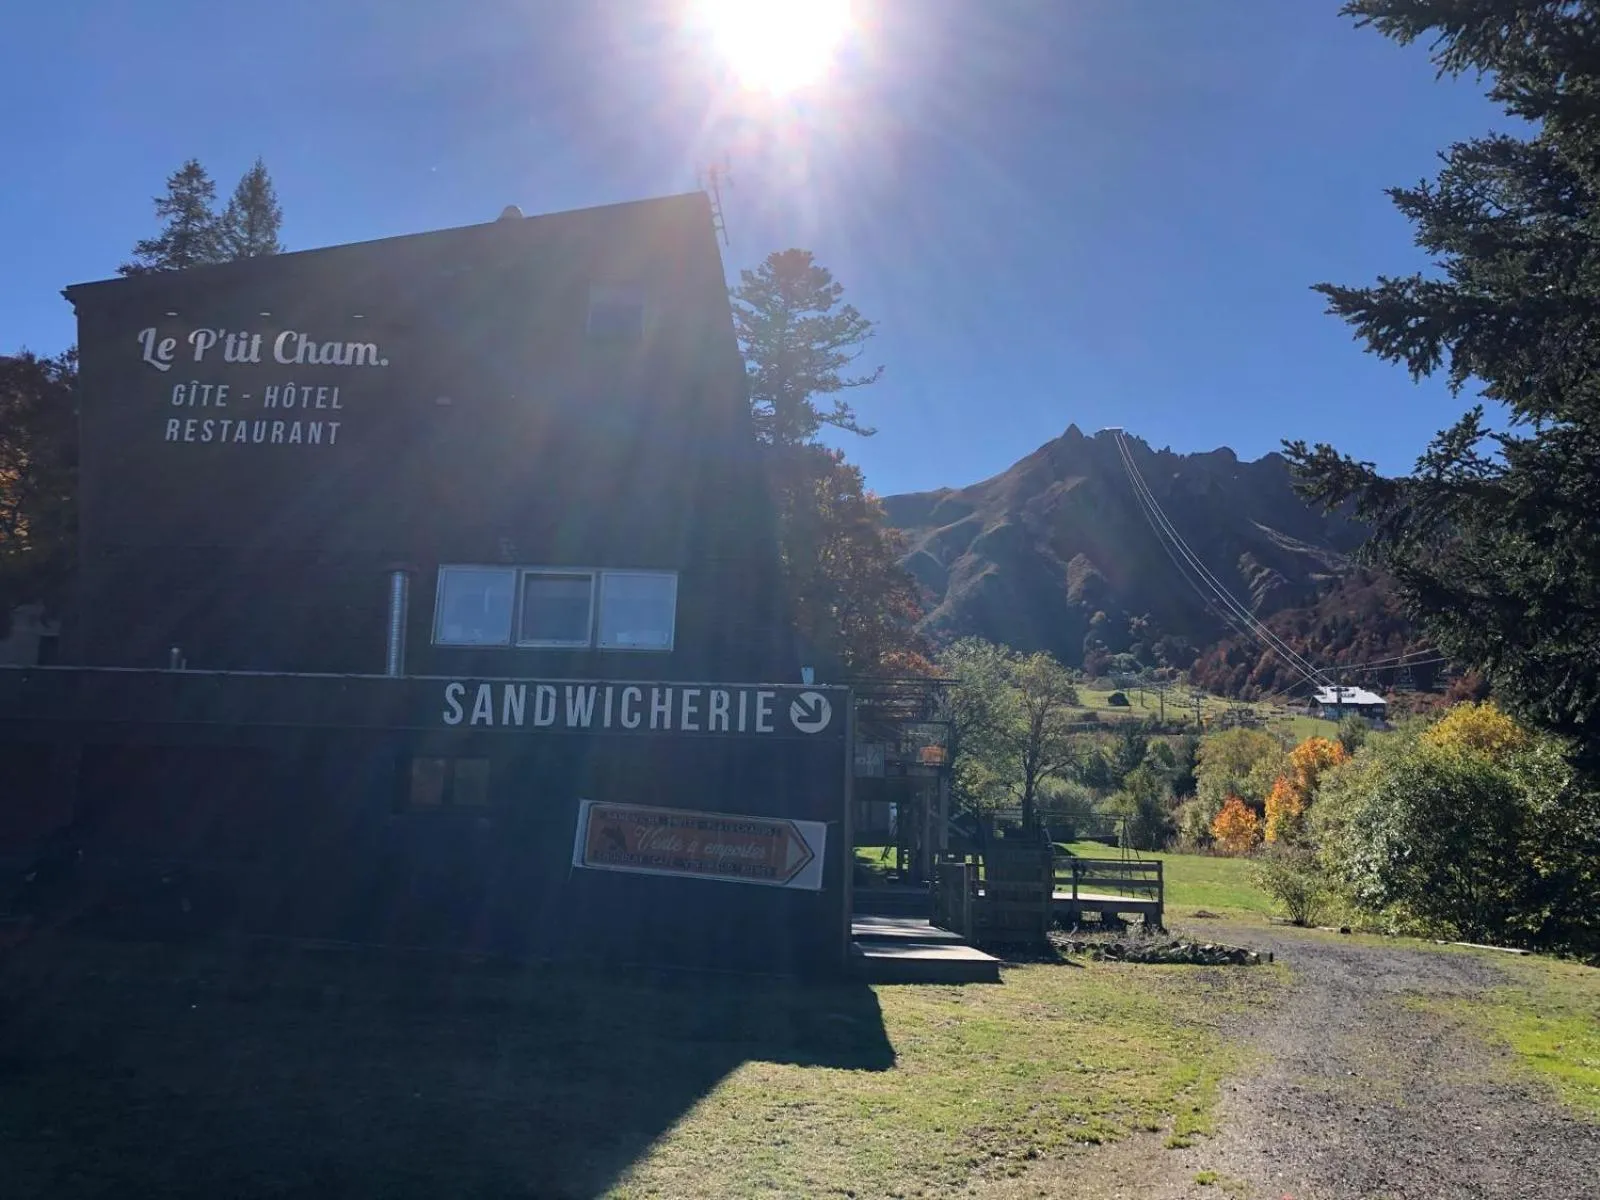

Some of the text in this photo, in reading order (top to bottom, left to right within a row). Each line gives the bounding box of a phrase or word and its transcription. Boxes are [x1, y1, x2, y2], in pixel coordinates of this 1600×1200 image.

[137, 327, 389, 372] Le P'tit Cham.
[171, 379, 230, 407] GÎTE
[264, 381, 343, 409] HÔTEL
[165, 418, 341, 445] RESTAURANT
[443, 682, 776, 732] SANDWICHERIE
